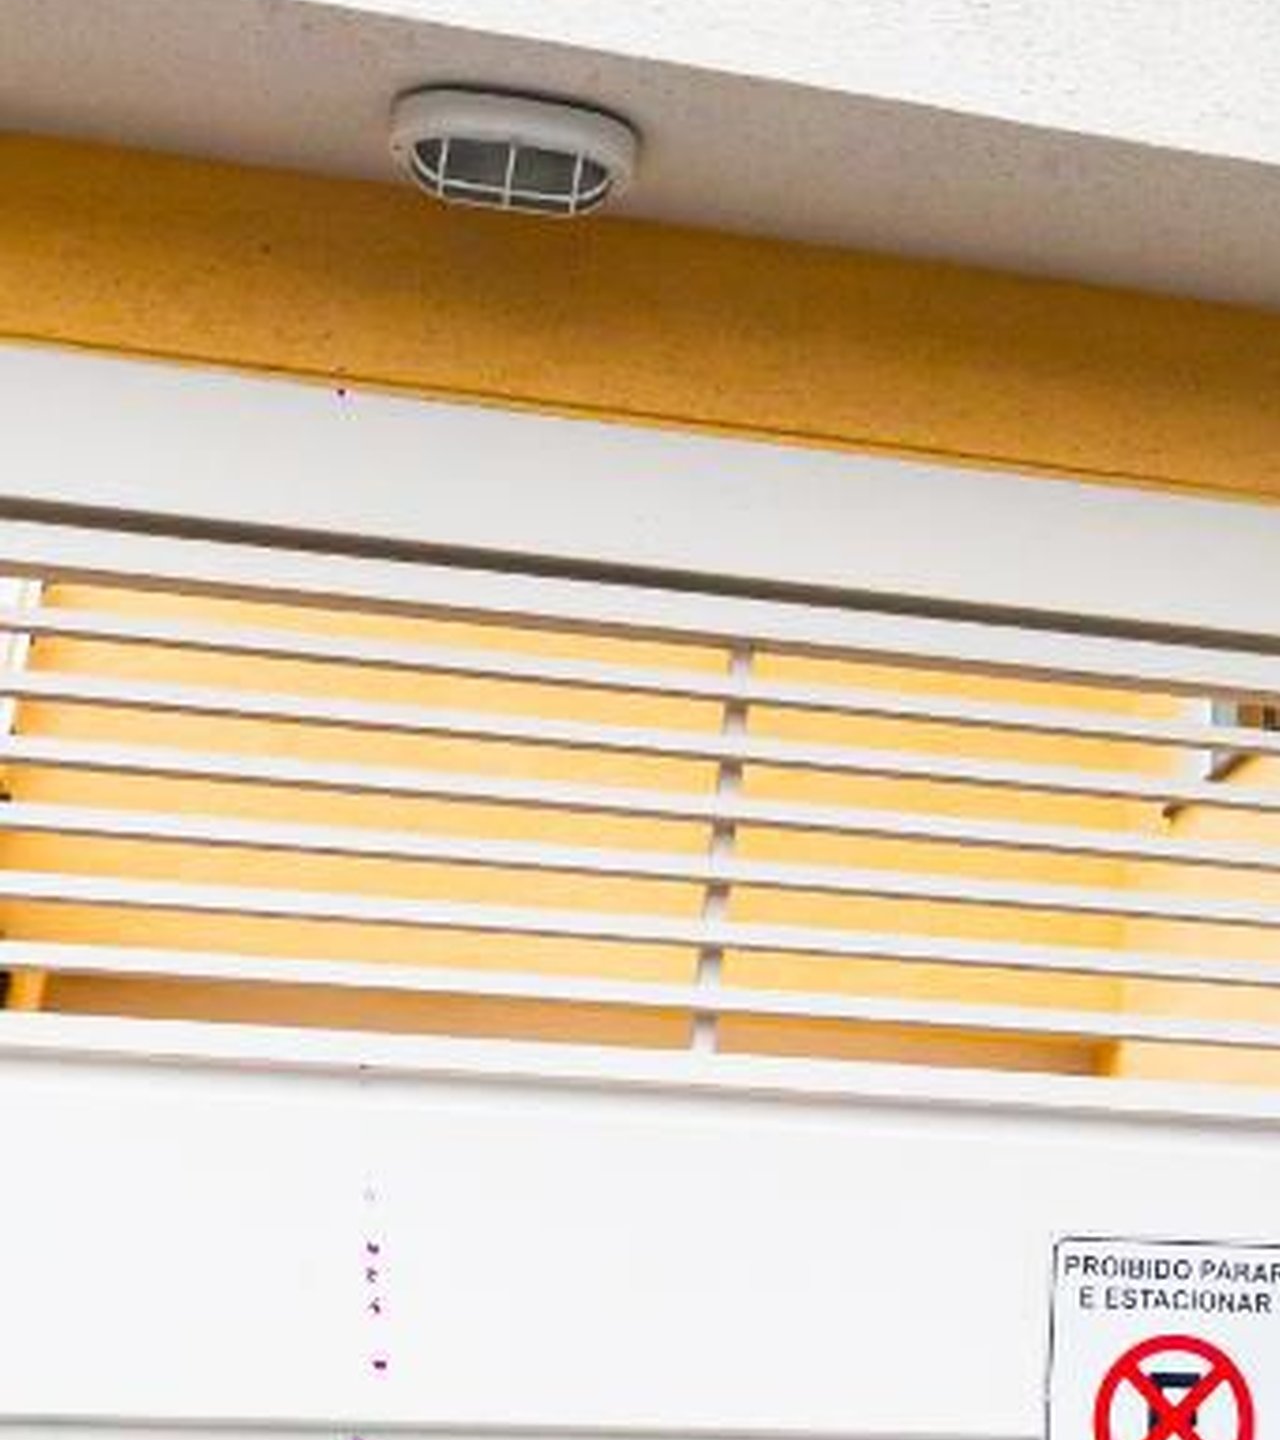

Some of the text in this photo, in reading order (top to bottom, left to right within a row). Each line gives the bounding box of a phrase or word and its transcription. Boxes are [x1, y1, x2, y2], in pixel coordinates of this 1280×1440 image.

[1064, 1253, 1194, 1280] PROIBIDO
[1079, 1285, 1272, 1314] E ESTACIONAR
